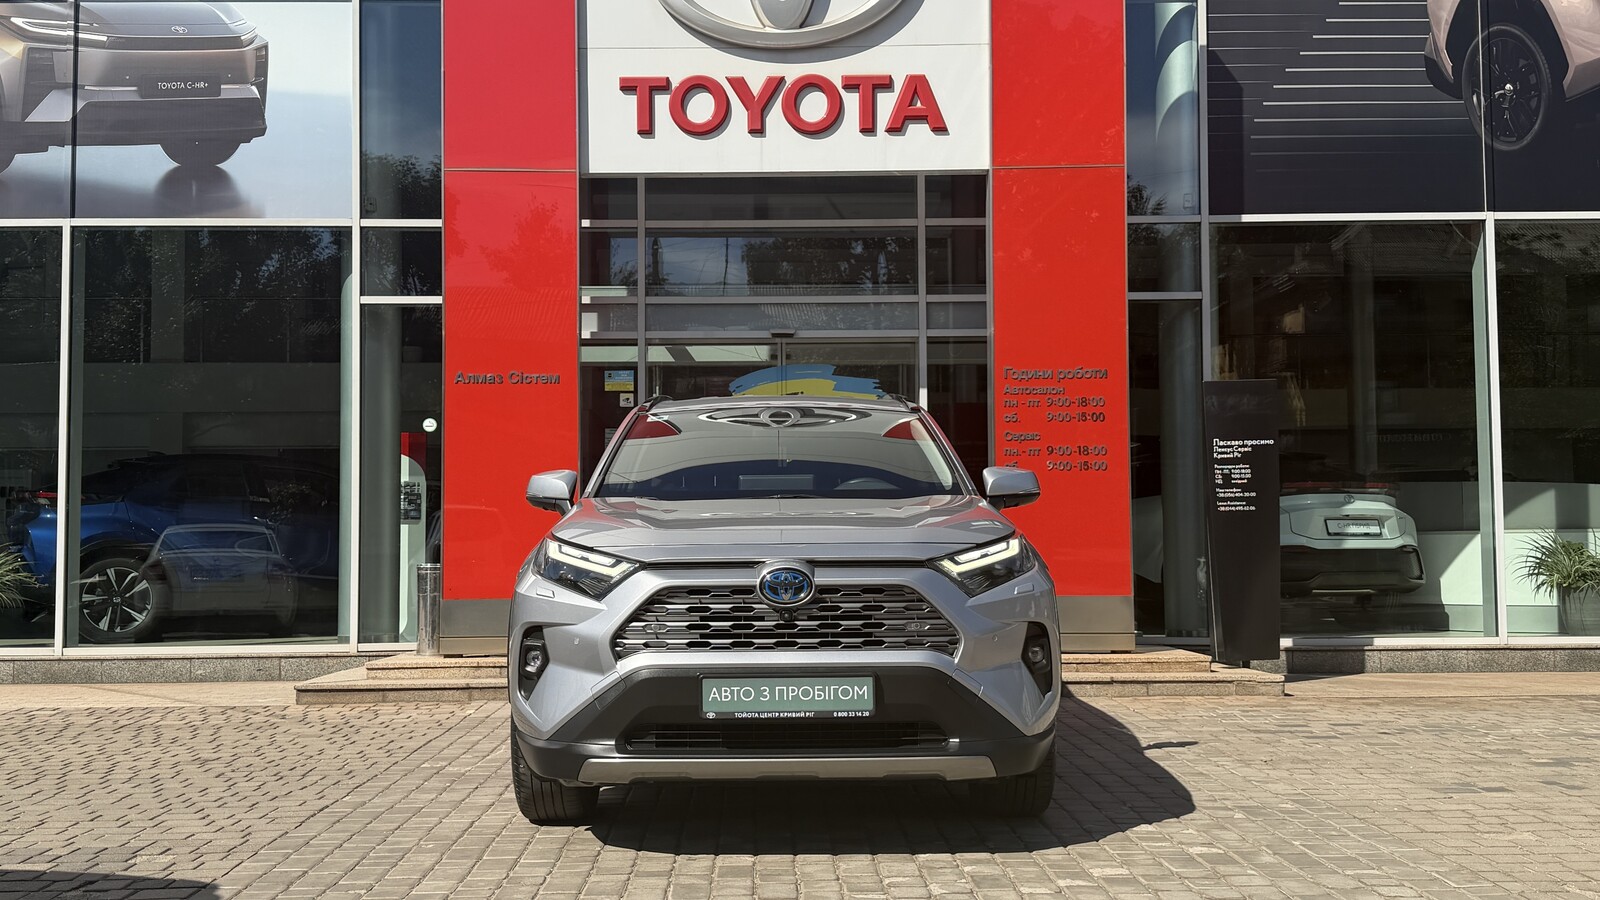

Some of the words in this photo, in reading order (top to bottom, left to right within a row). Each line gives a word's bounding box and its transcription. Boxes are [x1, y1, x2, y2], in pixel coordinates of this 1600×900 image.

[157, 82, 185, 90] TOYOTA
[186, 81, 209, 89] C-HR+
[619, 74, 950, 137] TOYOTA
[454, 371, 504, 385] Алмаз
[508, 371, 561, 385] Сістем
[1003, 367, 1053, 382] Години
[1057, 367, 1108, 383] роботи
[1003, 385, 1065, 395] Автосалон
[1046, 396, 1105, 407] 9:00-18:00
[1003, 412, 1021, 423] сб.
[1004, 431, 1041, 443] Сервіс
[1046, 445, 1107, 456] 9:00-18:00
[708, 686, 755, 702] АВТО
[775, 685, 868, 701] ПРОБІГОМ
[734, 711, 759, 719] ТОЙОТА
[759, 711, 780, 719] ЦЕНТР
